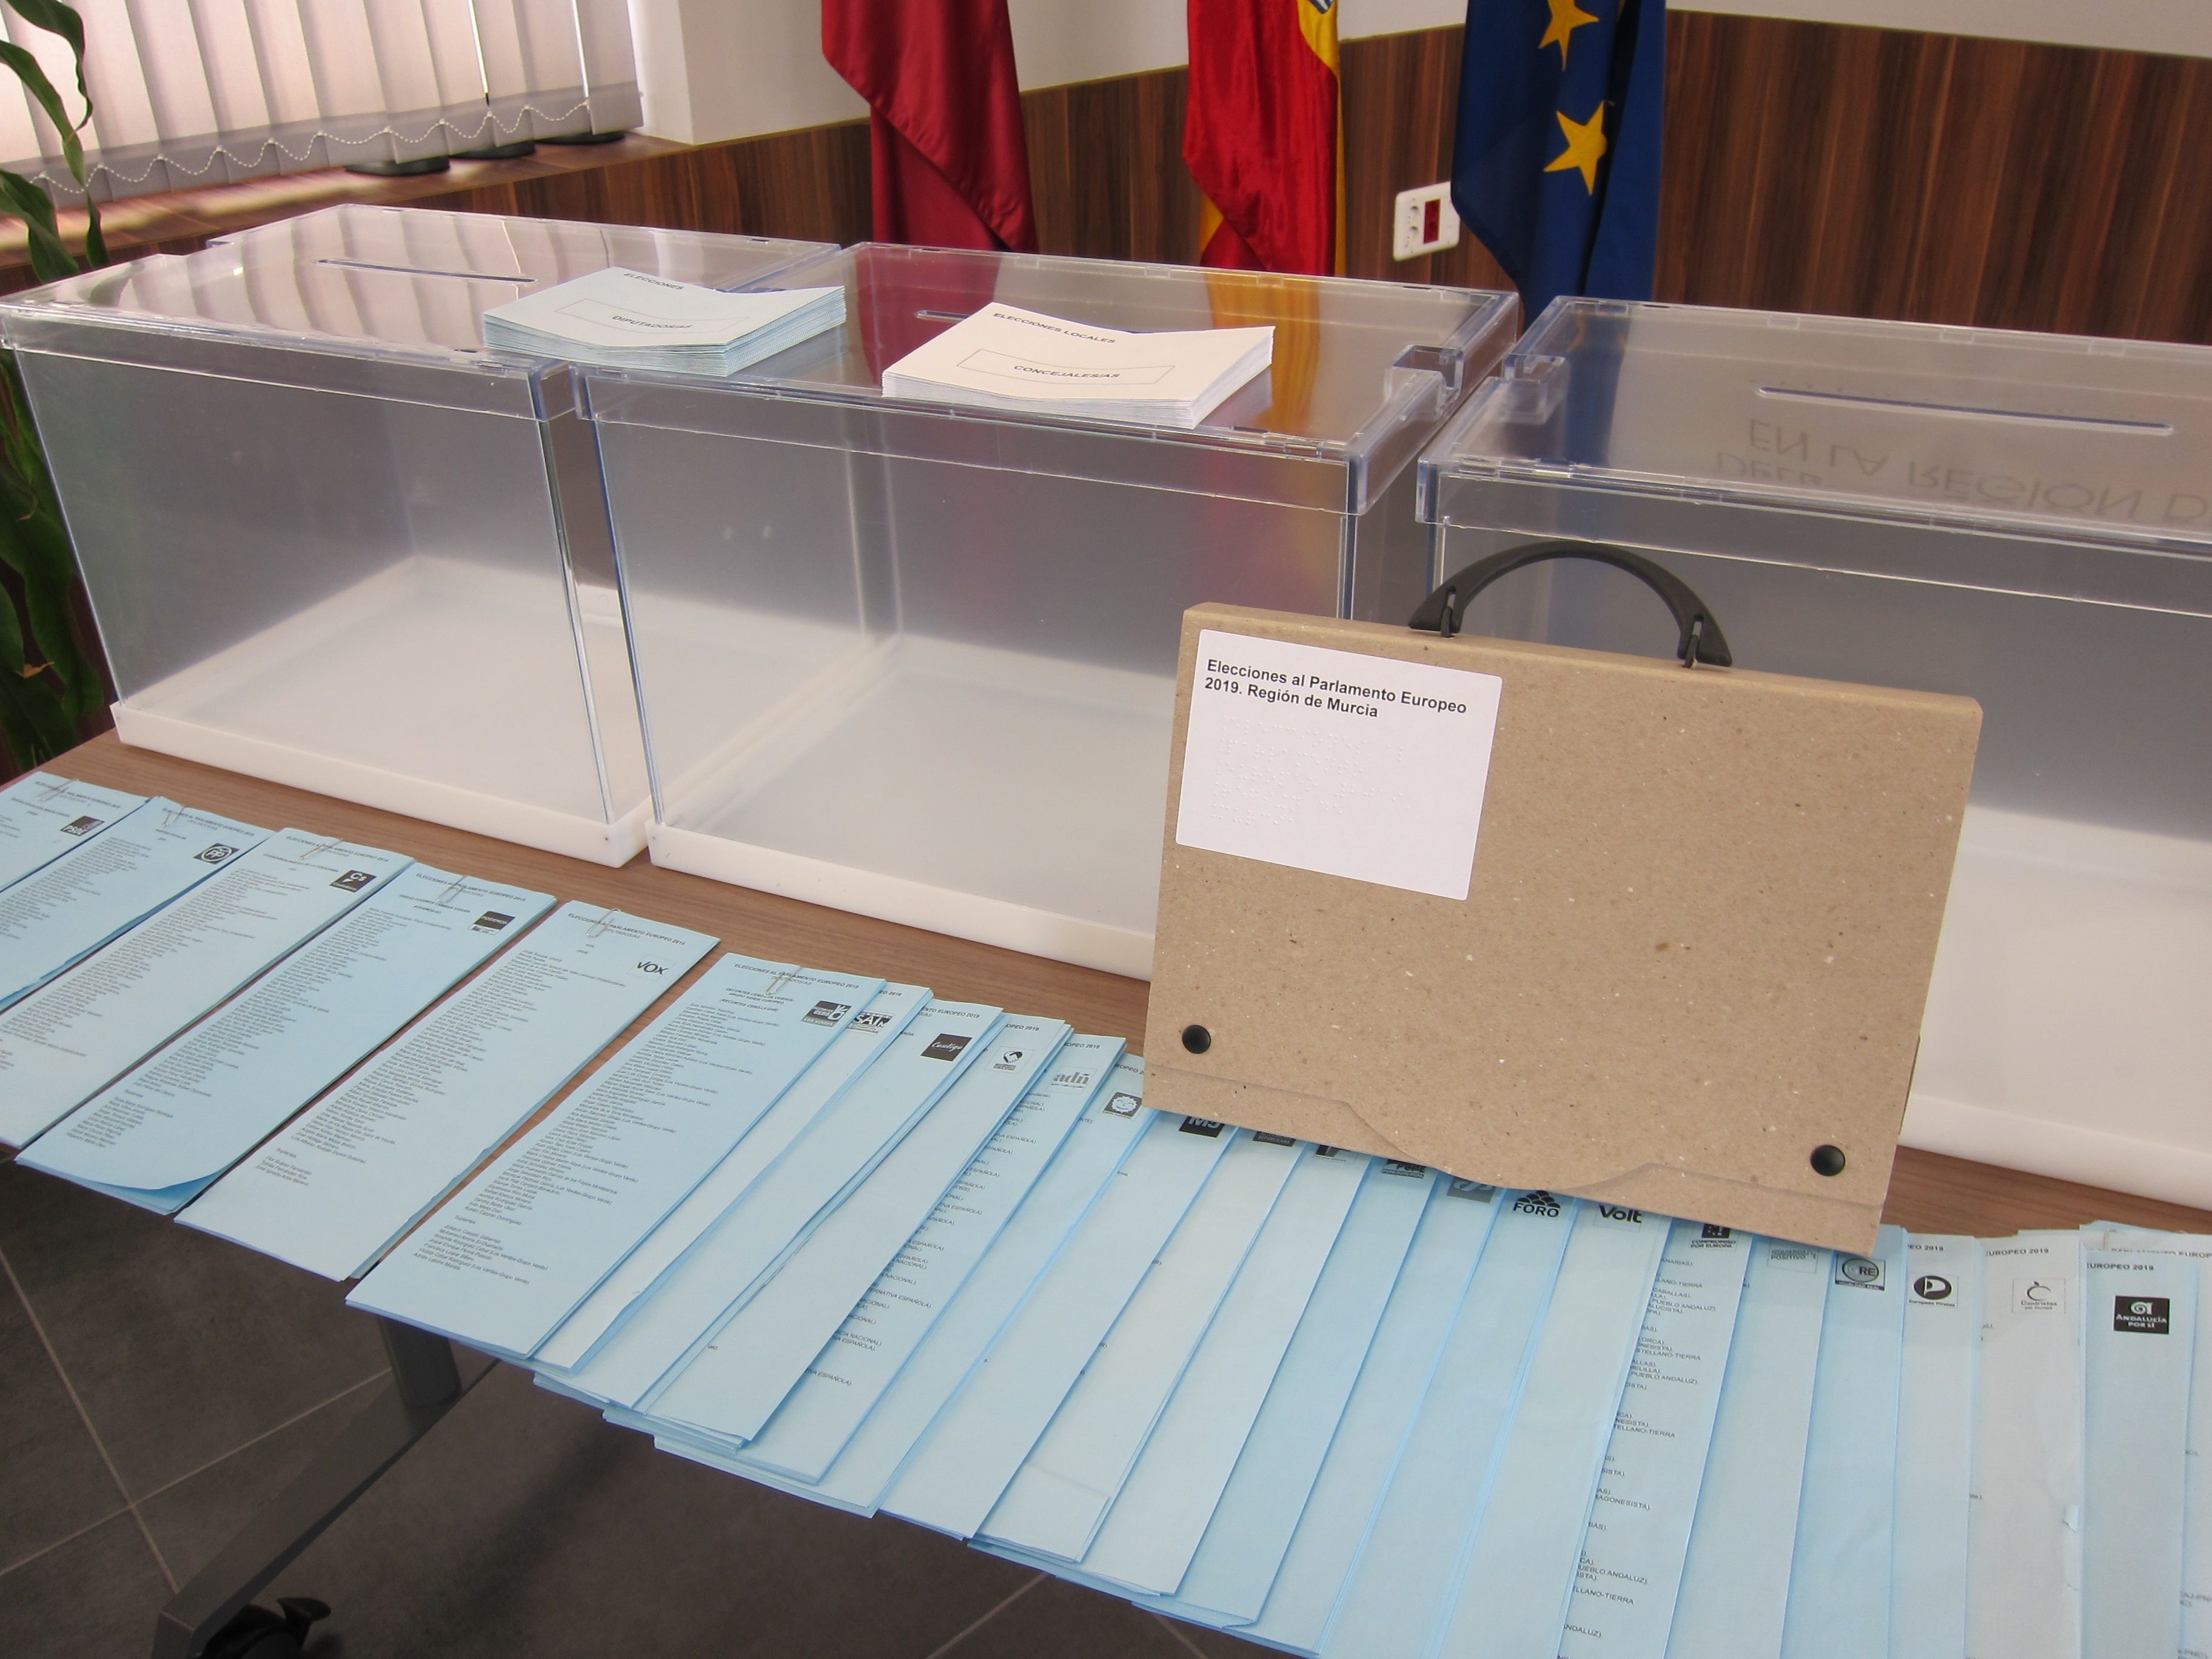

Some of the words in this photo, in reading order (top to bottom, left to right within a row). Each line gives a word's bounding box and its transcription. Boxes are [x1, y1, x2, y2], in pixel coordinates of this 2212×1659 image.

[624, 272, 685, 290] ELECCIONES
[993, 313, 1061, 333] ELECCIONES
[1064, 329, 1116, 344] LOCALES
[1014, 364, 1121, 379] CONCEJALES/AS
[1207, 659, 1287, 684] Elecciones
[1292, 674, 1305, 687] al
[1309, 676, 1396, 702] Parlamento
[1401, 691, 1467, 715] Europeo
[1205, 677, 1243, 695] 2019.
[1248, 685, 1299, 705] Región
[1305, 694, 1322, 707] de
[1327, 698, 1378, 718] Murcia
[206, 849, 226, 858] PP
[350, 873, 367, 882] Cs
[637, 961, 668, 974] VOX
[734, 964, 769, 974] ELECCIONES
[853, 1014, 887, 1028] SAIN
[931, 1042, 963, 1052] Contigo
[1513, 1202, 1560, 1218] FORO
[1598, 1205, 1643, 1223] Volt
